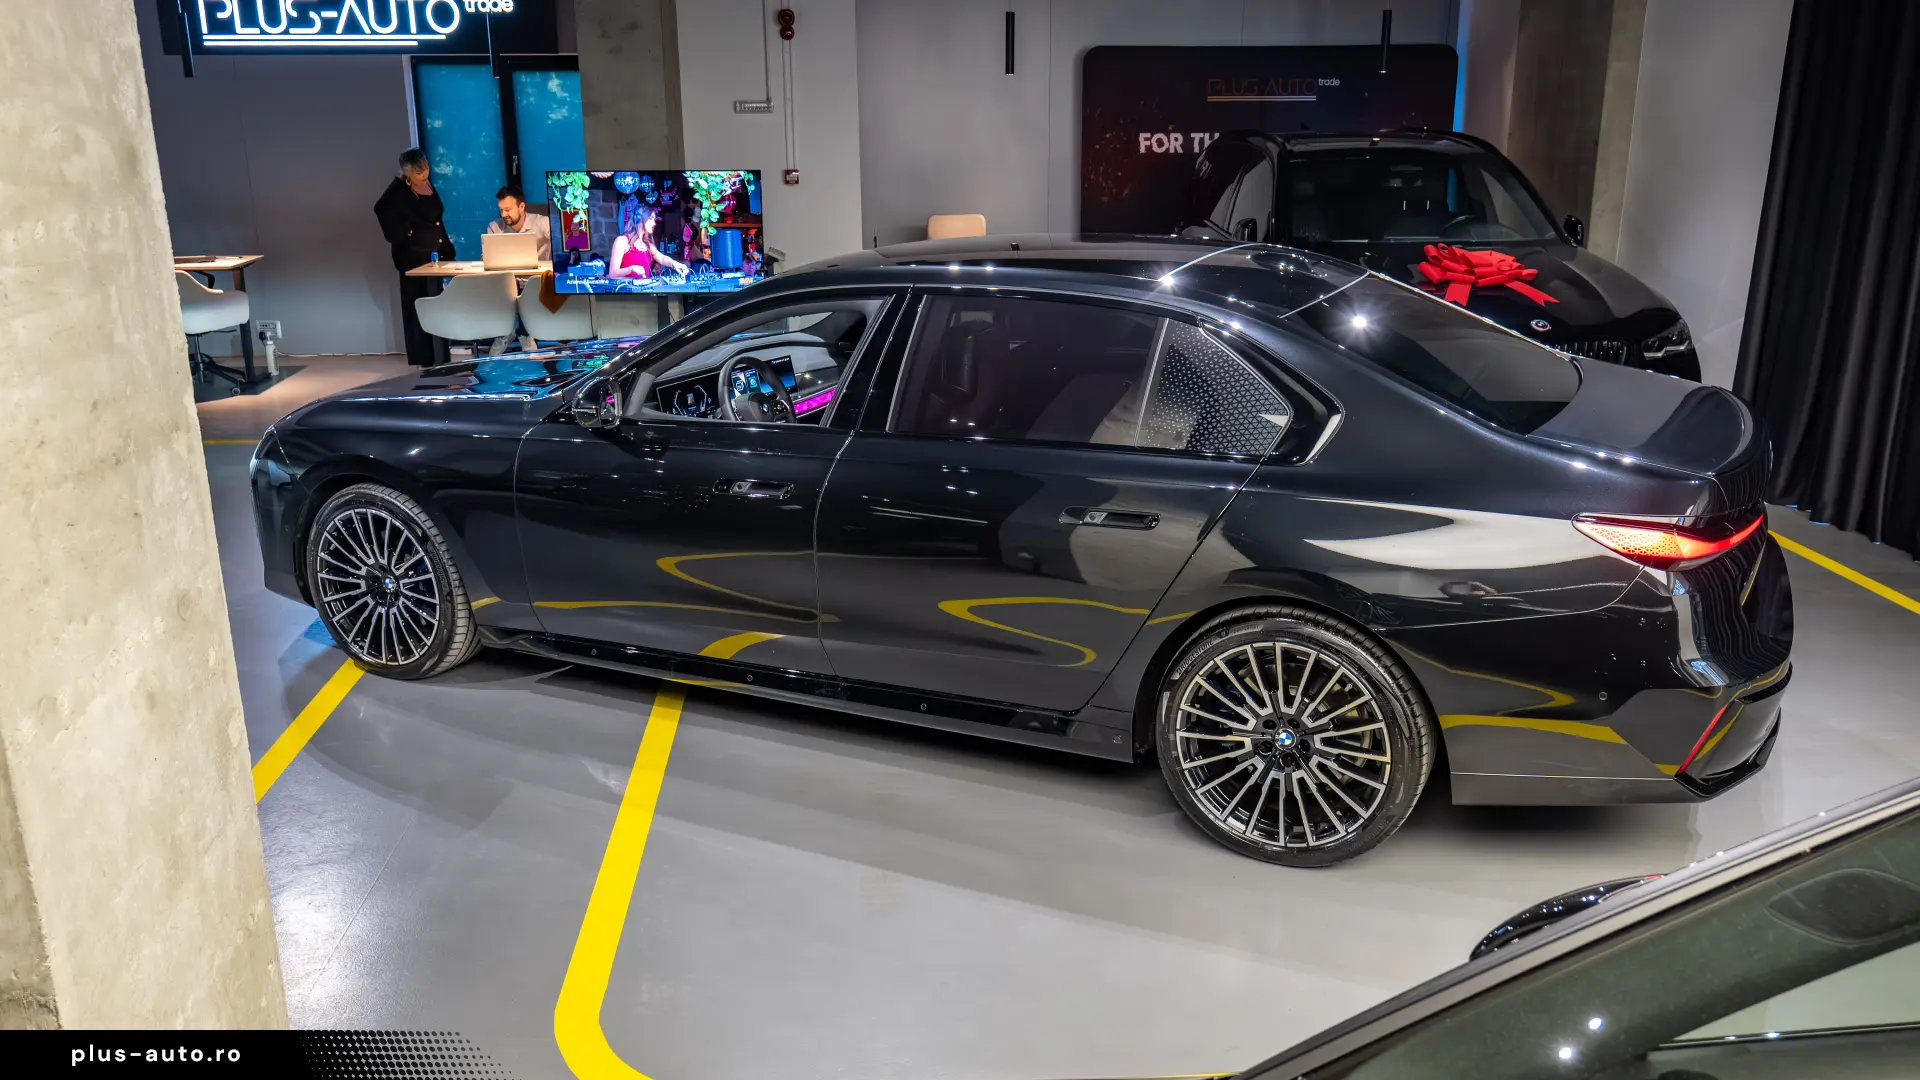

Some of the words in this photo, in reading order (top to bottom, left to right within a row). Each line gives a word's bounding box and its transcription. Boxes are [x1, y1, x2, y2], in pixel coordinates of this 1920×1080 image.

[198, 0, 460, 35] PLUS-AUTO
[1318, 78, 1341, 87] trade
[1139, 132, 1184, 154] FOR
